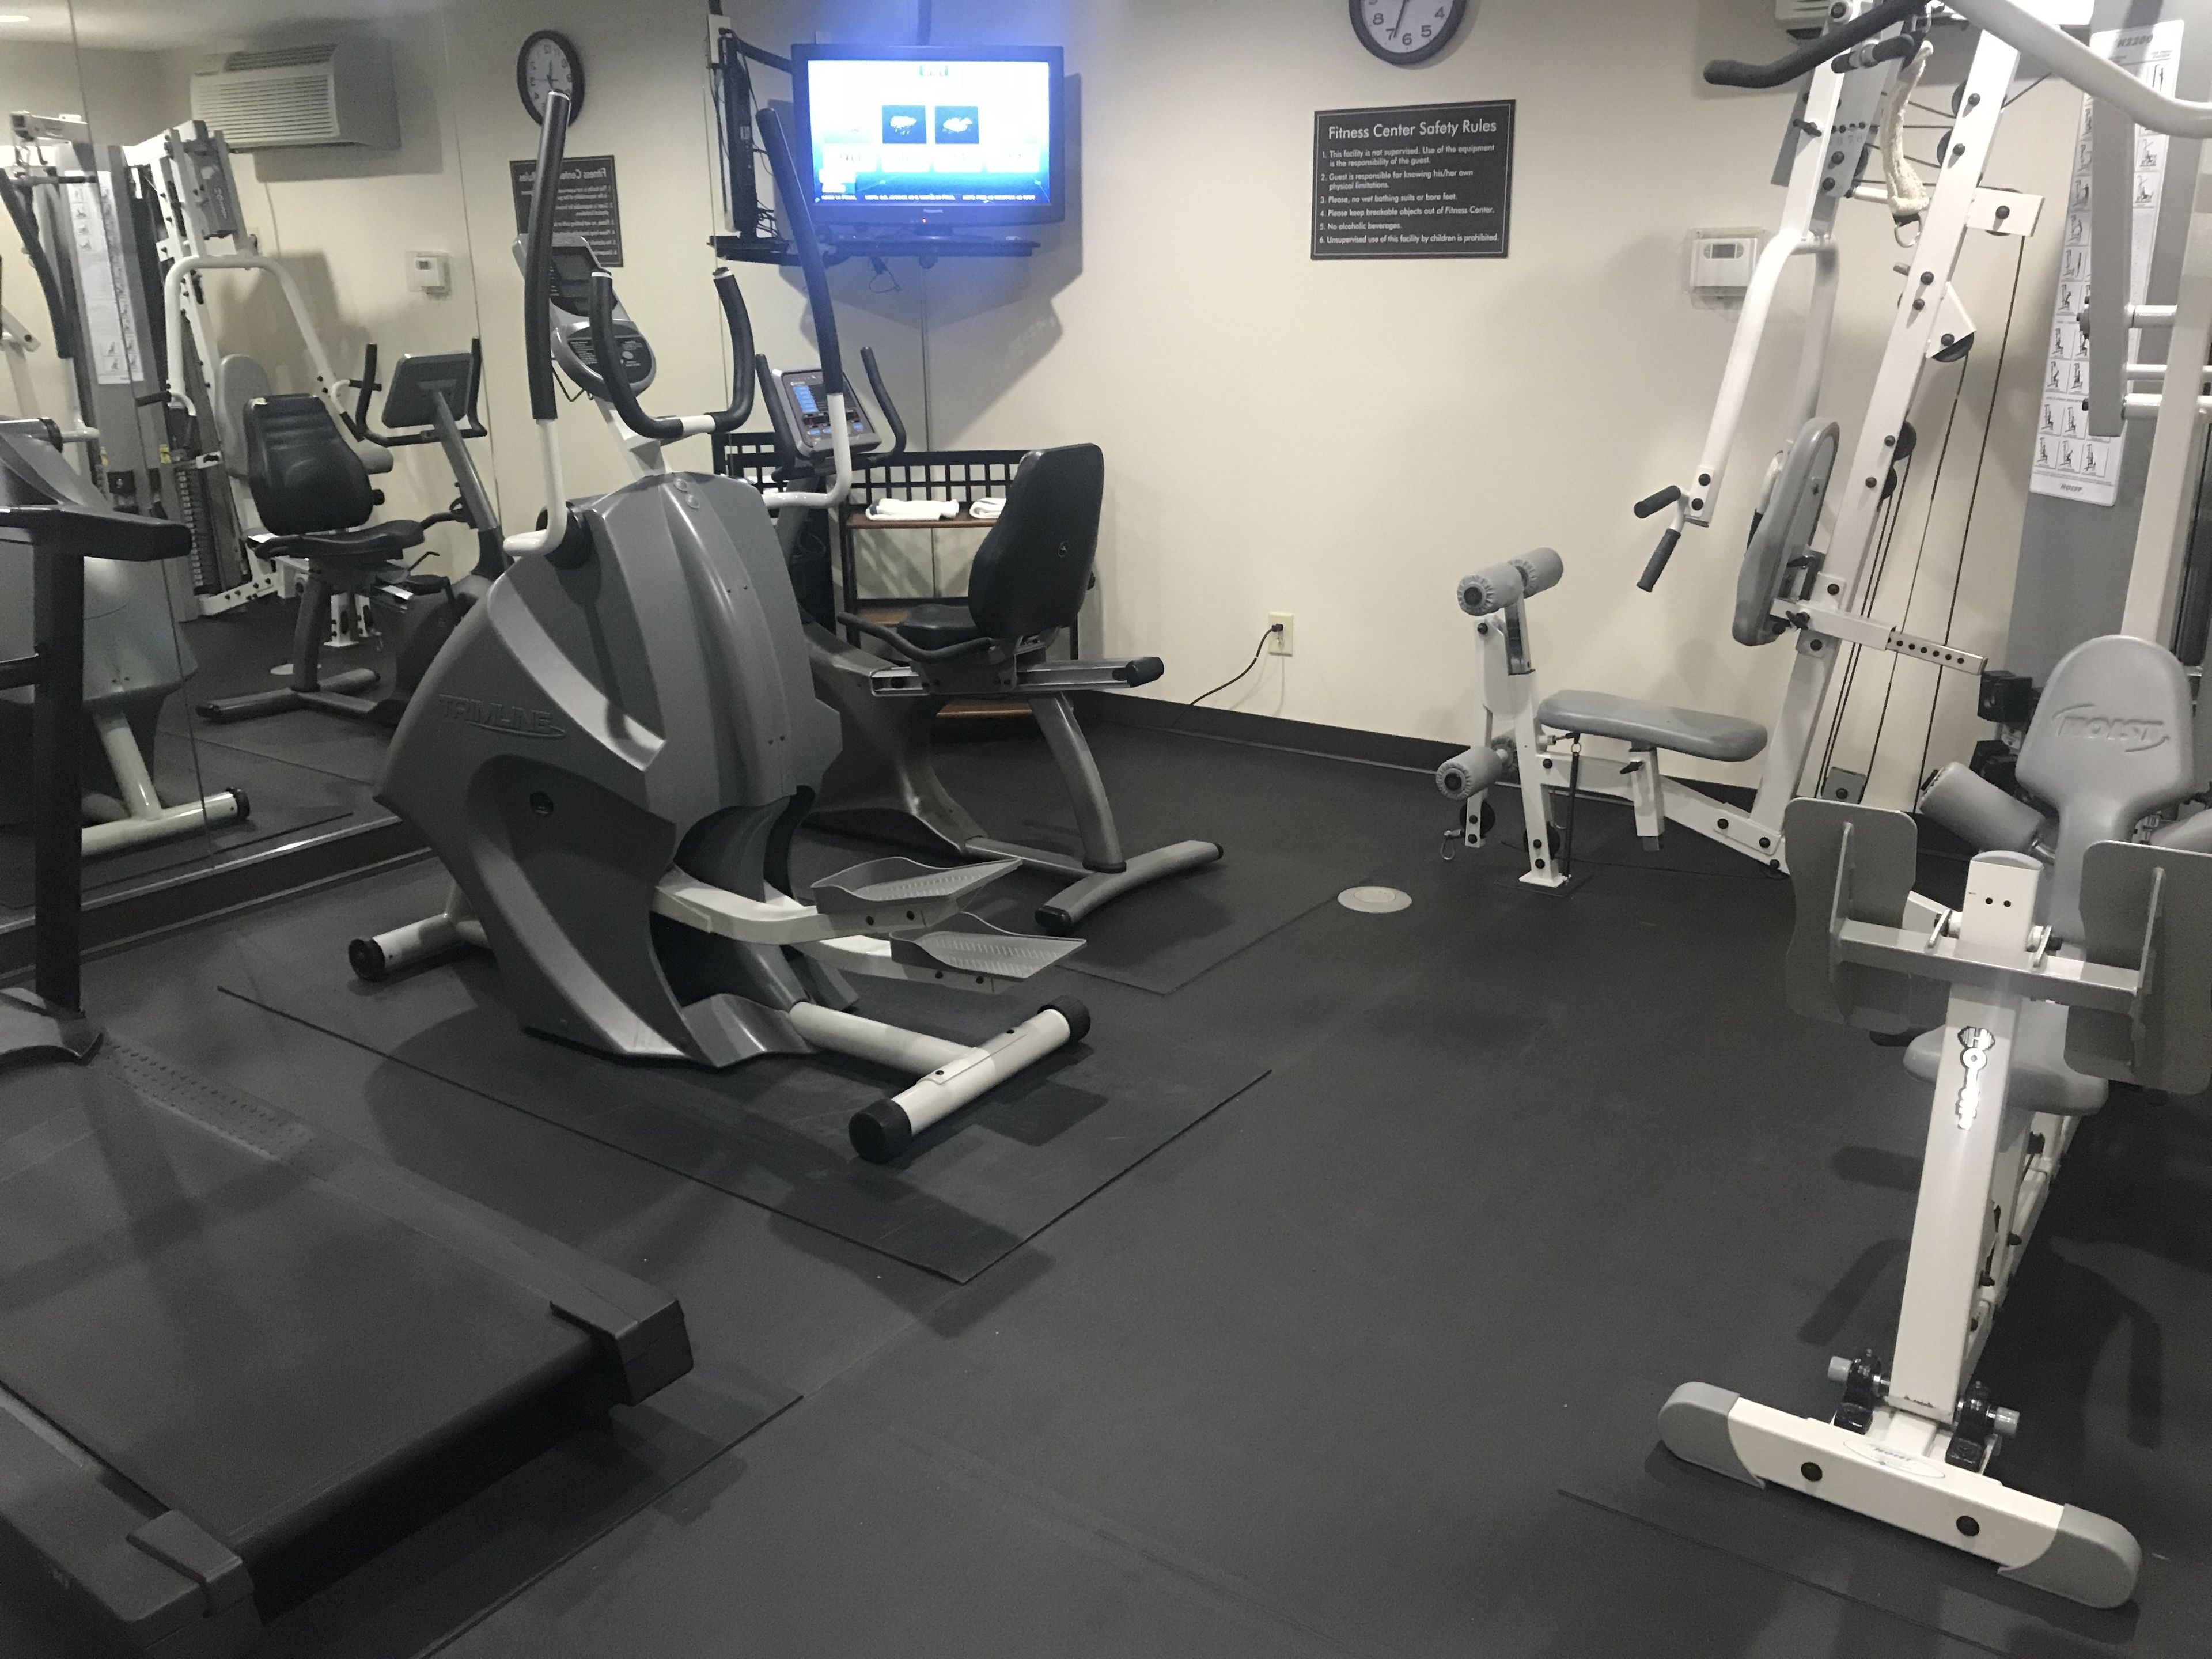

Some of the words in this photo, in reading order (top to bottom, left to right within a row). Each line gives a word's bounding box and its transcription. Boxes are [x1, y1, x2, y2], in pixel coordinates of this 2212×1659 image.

[1373, 13, 1384, 25] 8
[1434, 7, 1445, 19] 4
[1386, 28, 1395, 40] 7
[1421, 25, 1432, 37] 5
[1402, 33, 1412, 46] 6
[1328, 126, 1369, 139] Fitness
[1373, 123, 1416, 138] Center
[1419, 120, 1459, 137] Safety
[1463, 118, 1497, 133] Rules
[1343, 149, 1363, 158] facility
[1437, 145, 1444, 153] of
[1458, 145, 1495, 154] equipment
[1348, 158, 1389, 168] responsibility
[1355, 171, 1391, 180] responsible
[1404, 170, 1431, 179] knowing
[1433, 169, 1457, 177] his/her
[1329, 182, 1354, 191] physical
[1328, 195, 1350, 203] Please,
[1374, 194, 1399, 203] bathing
[1328, 209, 1348, 217] Please
[1349, 209, 1364, 218] keep
[1366, 207, 1398, 216] breakable
[1400, 207, 1422, 217] objects
[1437, 206, 1444, 214] of
[1339, 222, 1366, 230] alcoholic
[1327, 235, 1366, 245] Unsupervised
[1400, 234, 1420, 244] facility
[1421, 234, 1429, 244] by
[1430, 234, 1456, 242] children
[440, 694, 551, 729] TRIMLINE
[2058, 715, 2165, 740] HOIST
